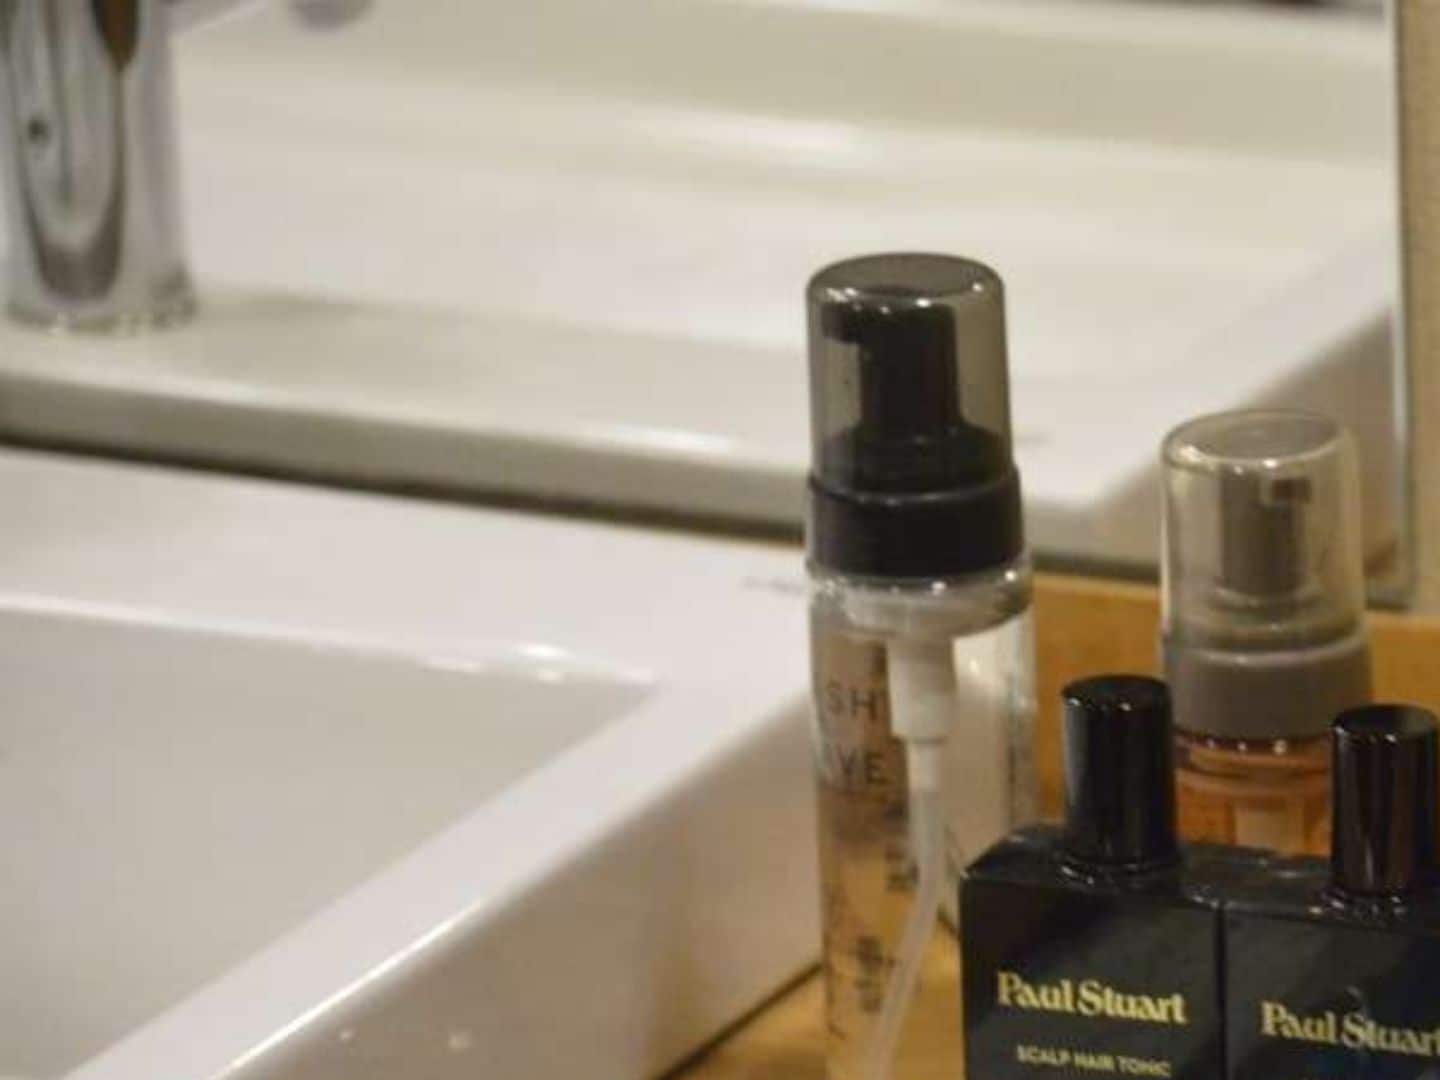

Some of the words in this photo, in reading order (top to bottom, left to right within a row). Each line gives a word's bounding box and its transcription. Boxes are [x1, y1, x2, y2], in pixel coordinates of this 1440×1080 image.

[997, 970, 1075, 1013] Paul
[1077, 978, 1188, 1025] Stuart
[1259, 1001, 1338, 1044] Paul
